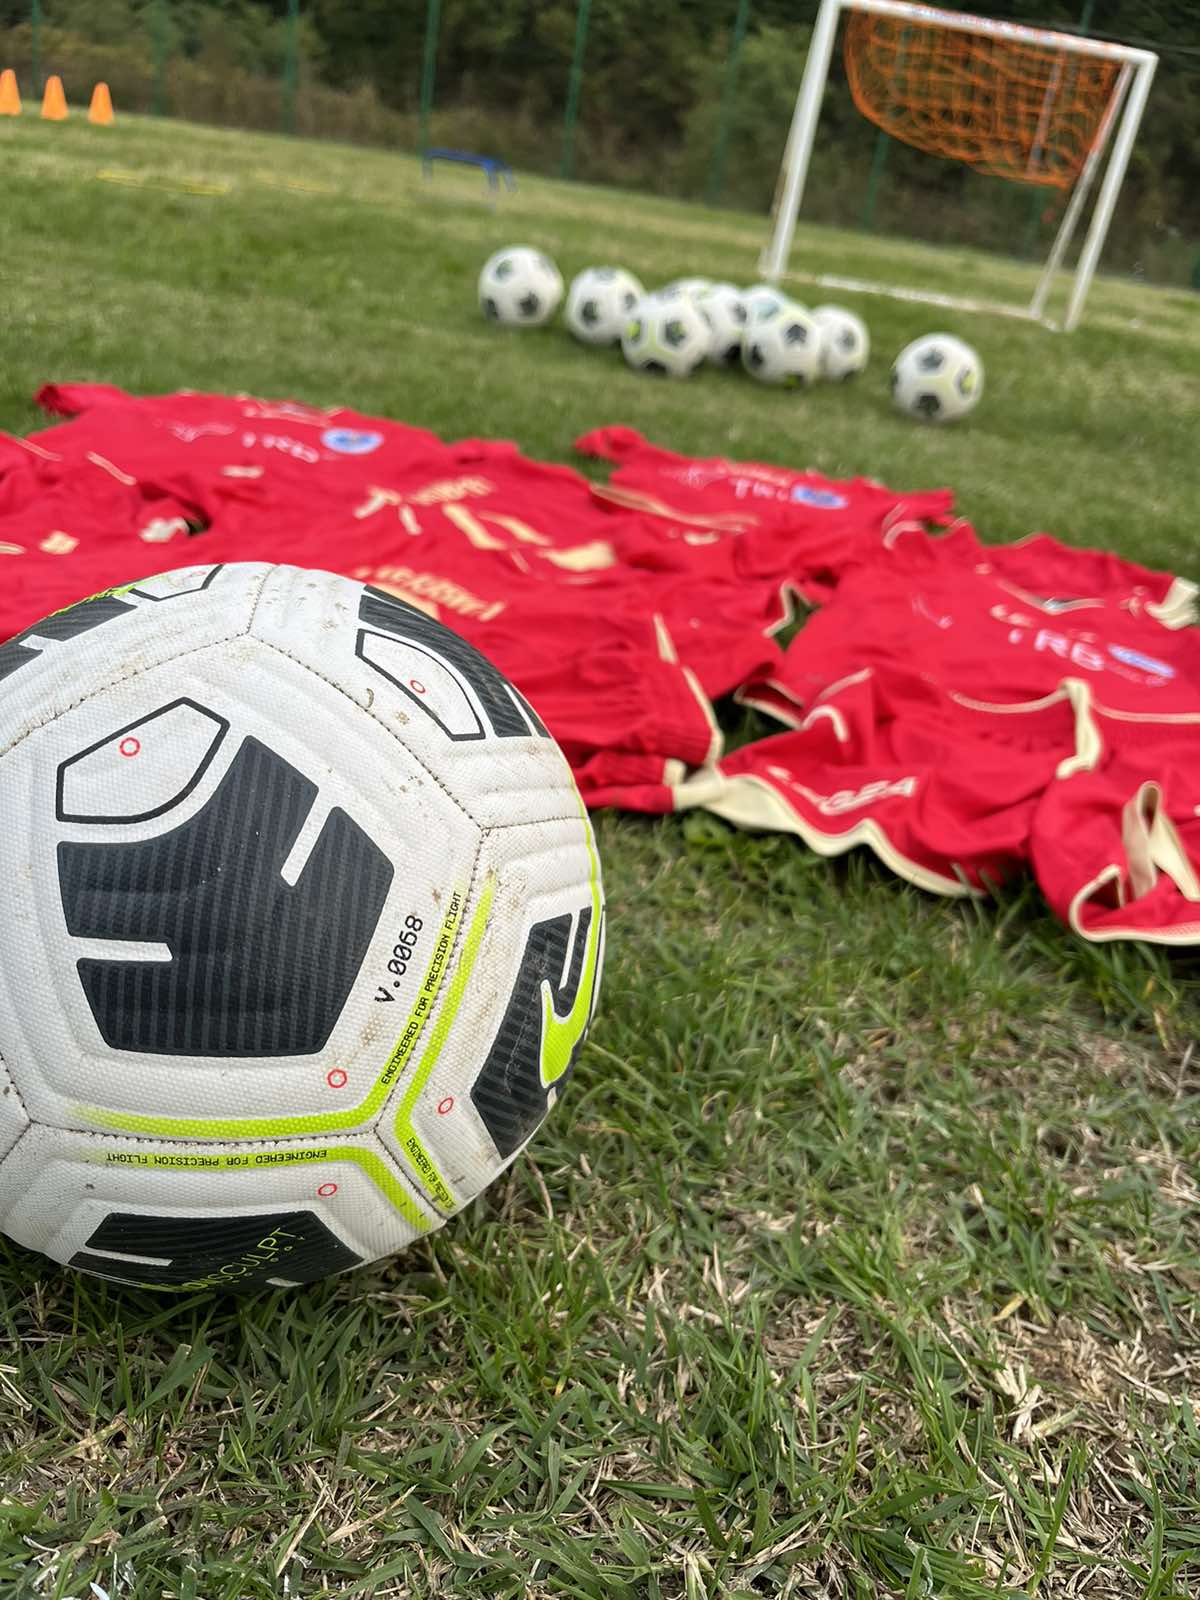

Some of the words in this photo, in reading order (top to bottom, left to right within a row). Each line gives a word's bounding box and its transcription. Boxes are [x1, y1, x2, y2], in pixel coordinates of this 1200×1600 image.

[381, 1021, 419, 1085] ENGINEERED
[415, 997, 430, 1018] FOR
[424, 934, 450, 992] PRECISION
[445, 892, 462, 931] FLIGHT
[105, 1152, 148, 1164] FLIGHT
[154, 1154, 219, 1167] PRECISION
[226, 1156, 249, 1166] FOR
[255, 1149, 327, 1166] ENGINEERED
